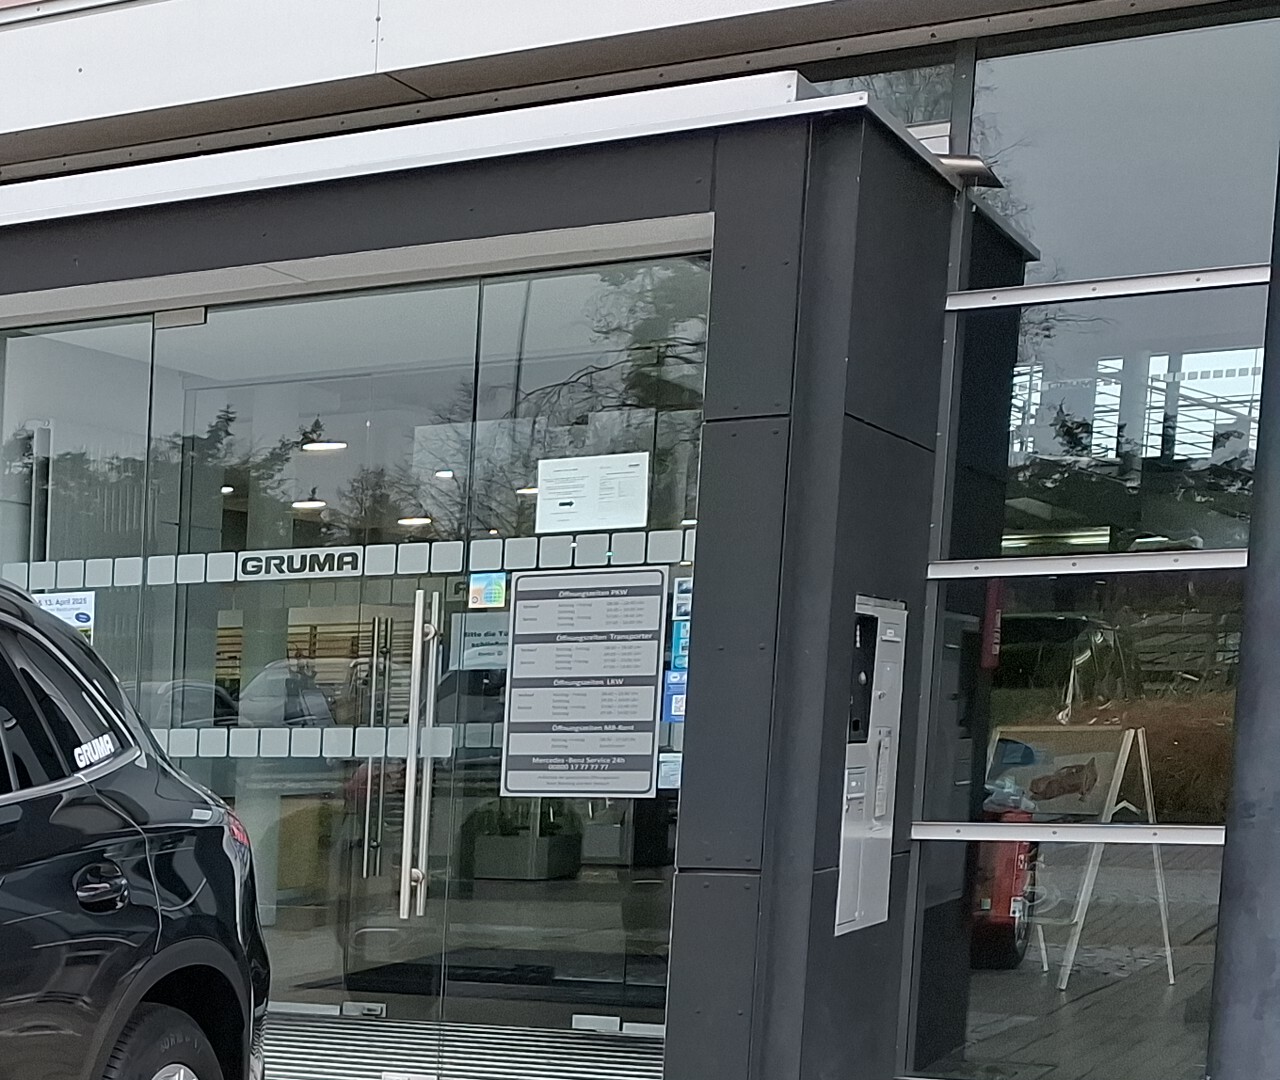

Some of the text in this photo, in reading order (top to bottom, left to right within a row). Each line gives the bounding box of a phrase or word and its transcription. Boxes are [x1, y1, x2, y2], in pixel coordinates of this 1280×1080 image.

[241, 552, 359, 575] GRUMA
[610, 632, 653, 641] Transporter
[74, 734, 115, 768] GRUMA
